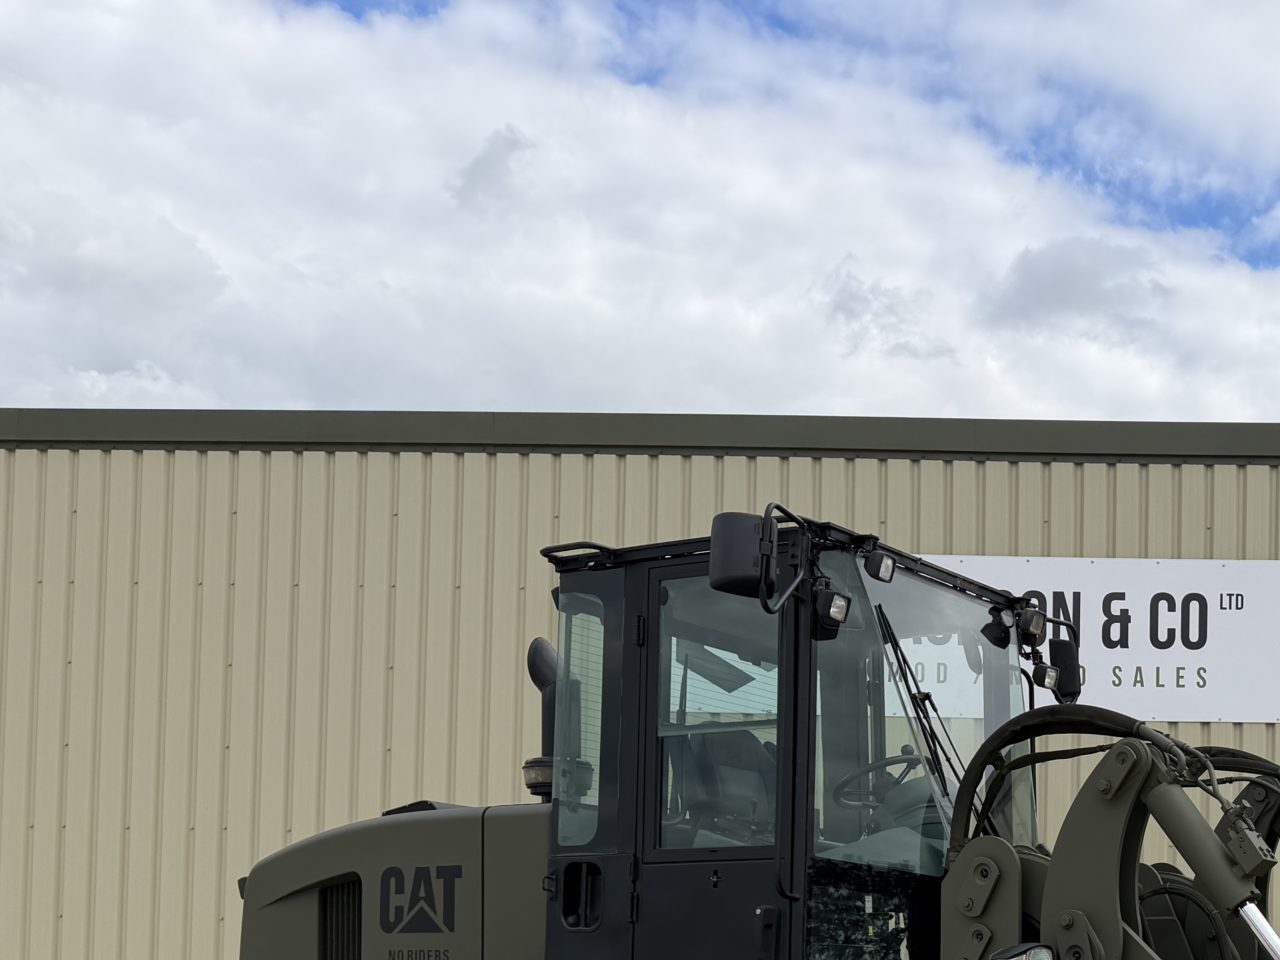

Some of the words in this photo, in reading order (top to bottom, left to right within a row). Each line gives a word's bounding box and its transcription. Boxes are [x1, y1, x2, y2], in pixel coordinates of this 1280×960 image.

[1101, 592, 1132, 649] &
[1149, 592, 1208, 650] CO
[1219, 593, 1244, 610] LTD
[1112, 666, 1207, 688] SALES
[380, 865, 462, 934] CAT
